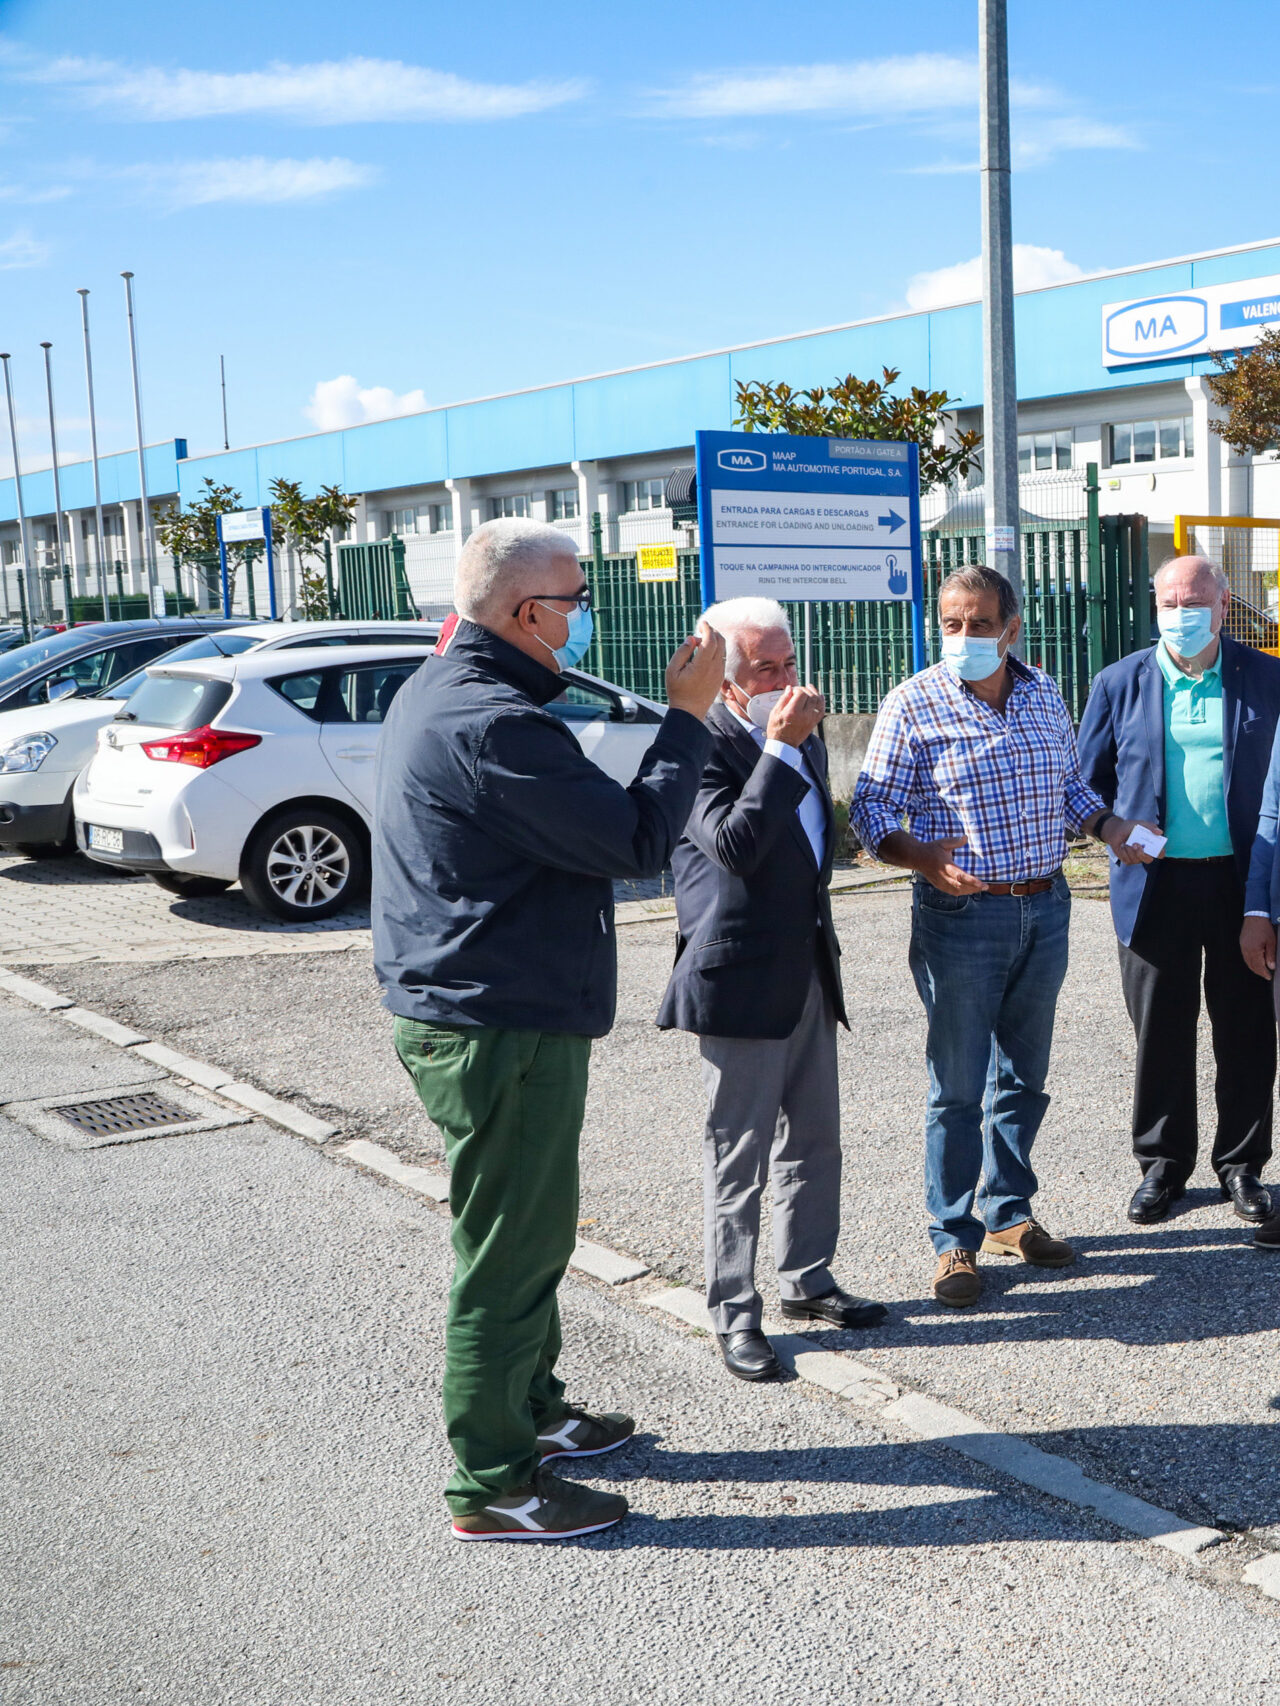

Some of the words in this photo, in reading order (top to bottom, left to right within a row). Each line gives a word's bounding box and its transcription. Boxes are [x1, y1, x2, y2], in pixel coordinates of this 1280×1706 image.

[1135, 314, 1177, 341] MA
[772, 451, 797, 461] MAAP
[835, 446, 866, 455] PORTÃO
[866, 447, 872, 455] A
[876, 448, 895, 457] GATE
[896, 449, 902, 457] A
[731, 455, 753, 466] MA
[773, 463, 786, 472] MA
[787, 464, 840, 475] AUTOMOTIVE
[887, 468, 903, 477] S.A.
[721, 505, 759, 514] ENTRADA
[760, 507, 782, 515] PARA
[783, 507, 816, 516] CARGAS
[817, 508, 822, 516] E
[823, 508, 869, 518] DESCARGAS
[716, 521, 759, 529] ENTRANCE
[760, 521, 777, 529] FOR
[778, 521, 813, 530] LOADING
[814, 522, 830, 530] AND
[831, 523, 875, 532] UNLOADING
[719, 563, 745, 571] TOQUE
[746, 563, 757, 571] NA
[758, 563, 799, 571] CAMPAINHA
[812, 564, 882, 572] INTERCOMUNICADOR
[792, 577, 829, 585] INTERCOM
[830, 577, 848, 585] BELL
